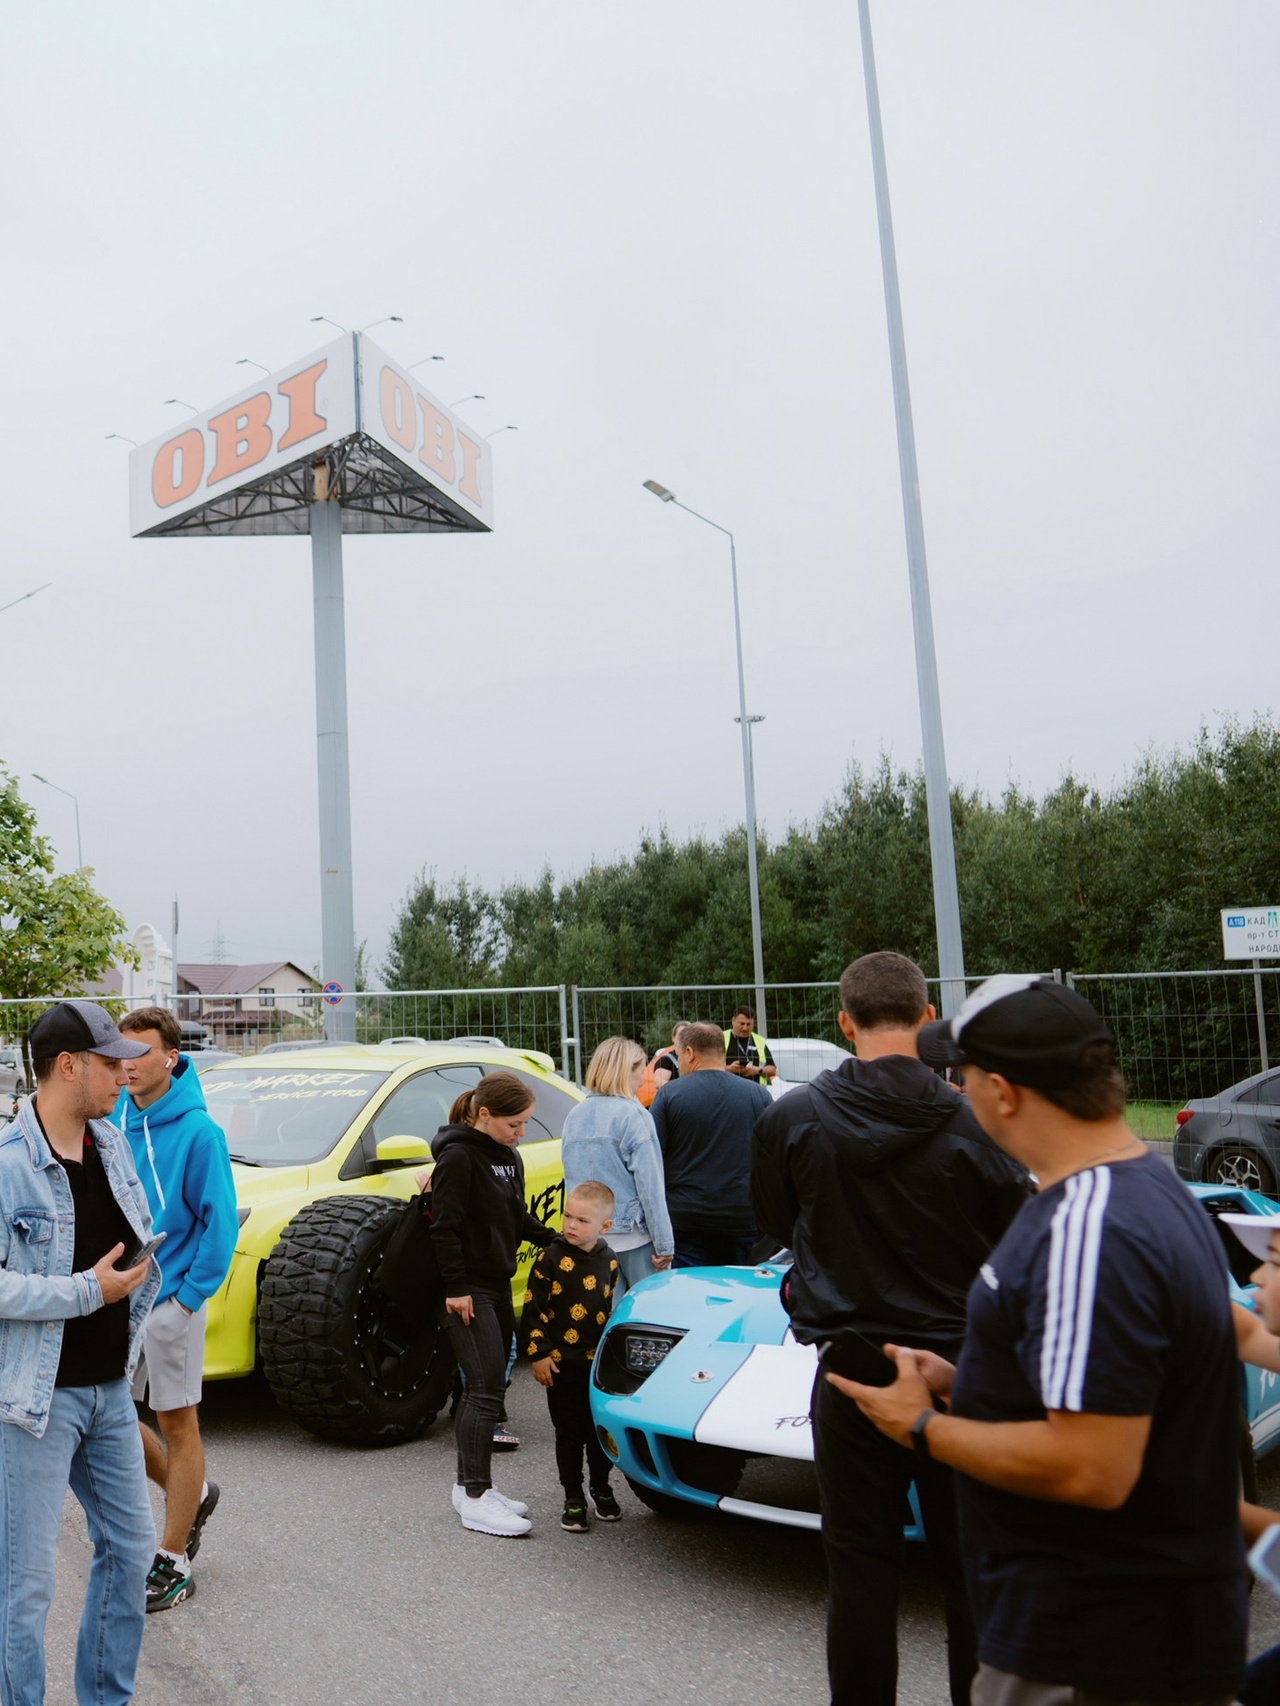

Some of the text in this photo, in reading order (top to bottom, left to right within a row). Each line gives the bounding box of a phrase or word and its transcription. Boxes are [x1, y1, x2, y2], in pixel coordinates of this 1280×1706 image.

[151, 358, 328, 509] OBI
[378, 364, 482, 507] OBI
[1247, 916, 1266, 925] КАД
[1268, 930, 1280, 938] СТ
[1248, 944, 1280, 953] НАРОД
[322, 1089, 368, 1098] FORD
[775, 1415, 811, 1430] FO
